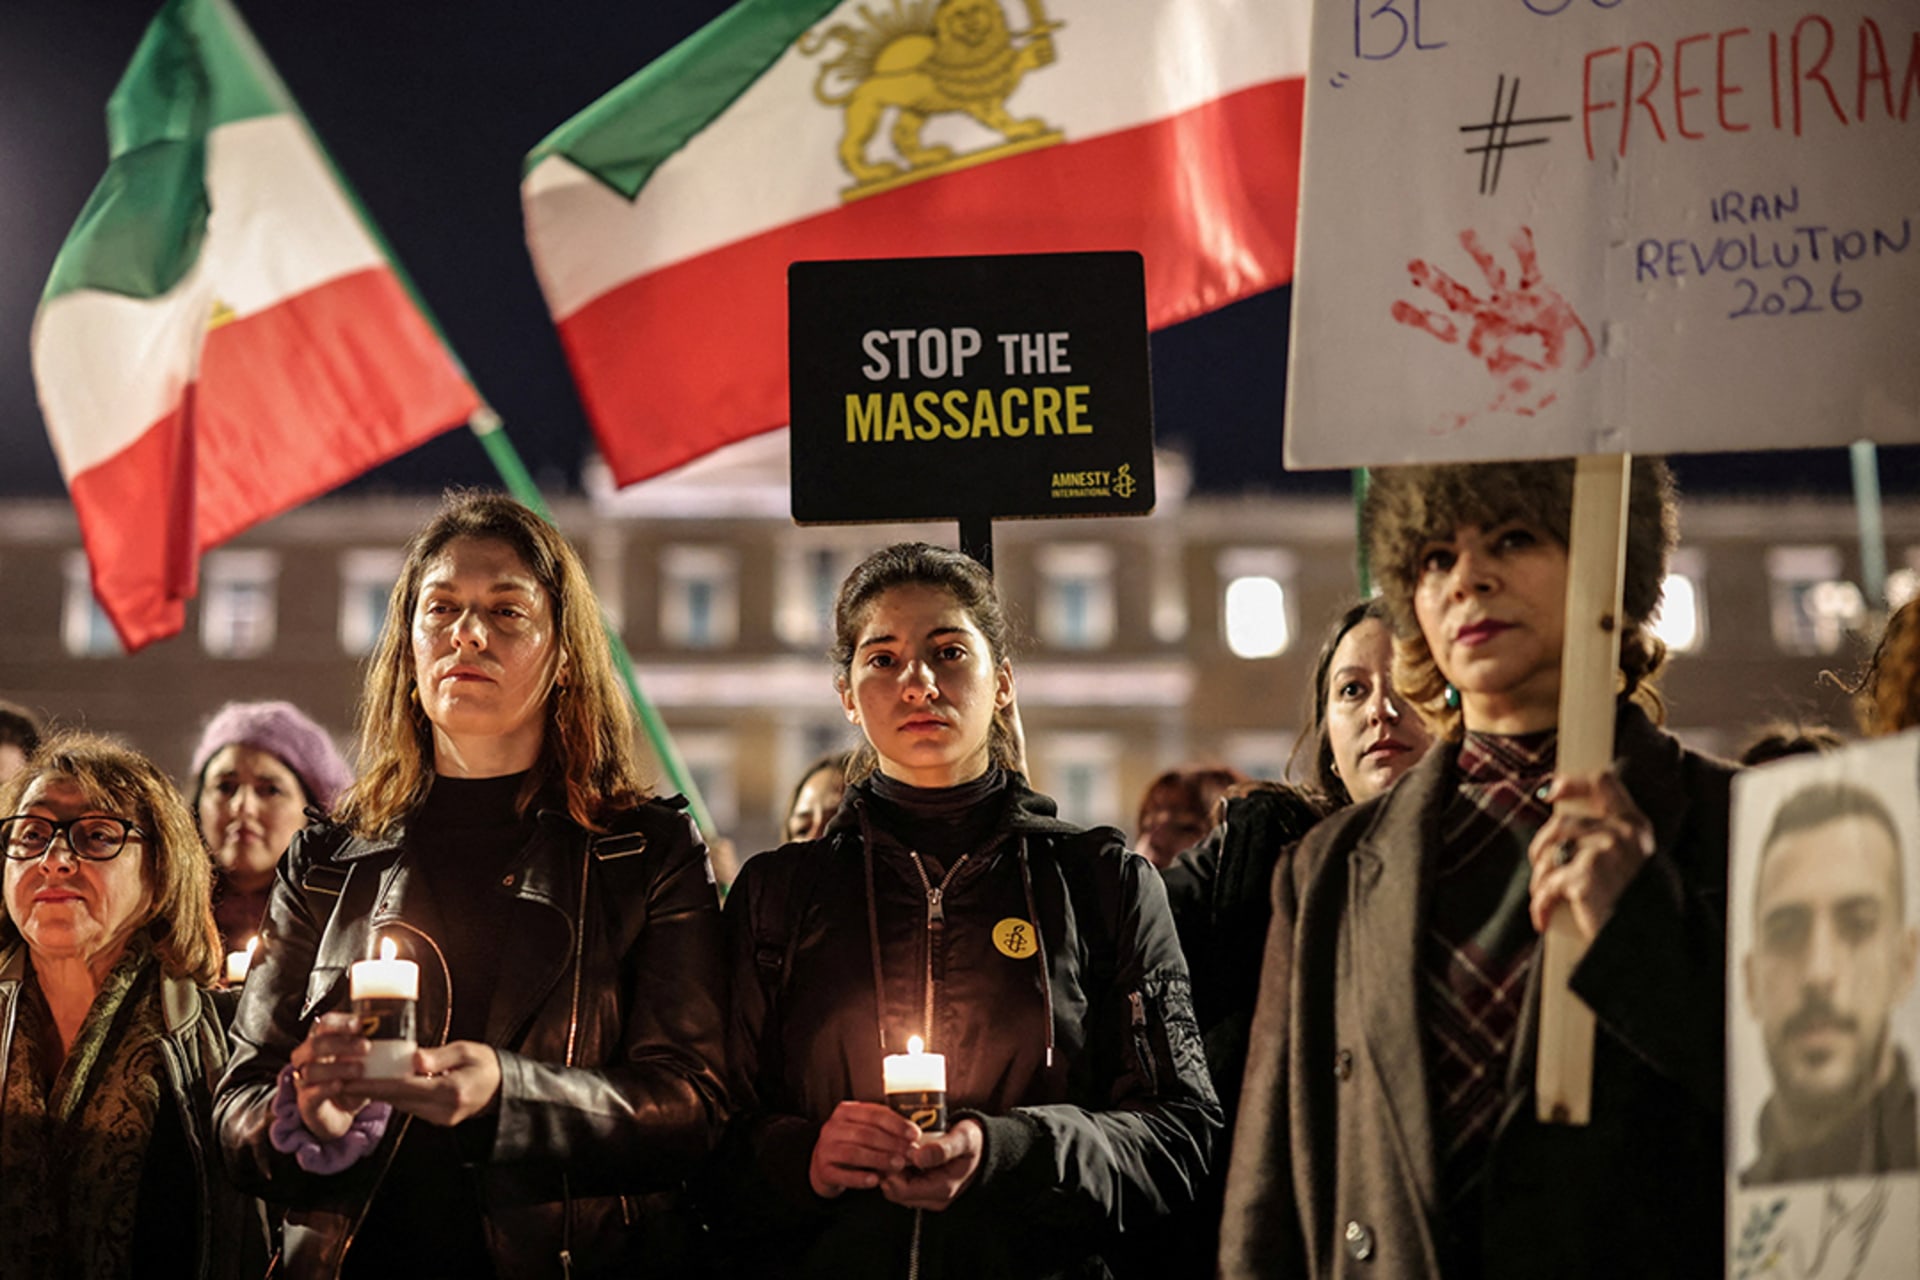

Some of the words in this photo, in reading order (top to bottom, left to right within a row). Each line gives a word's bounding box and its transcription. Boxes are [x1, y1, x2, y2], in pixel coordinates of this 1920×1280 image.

[1710, 186, 1798, 225] IRAN
[1635, 219, 1911, 282] REVOLUTION
[1728, 272, 1863, 319] 2026
[862, 328, 982, 381] STOP
[997, 332, 1072, 376] THE
[845, 385, 1094, 443] MASSACRE
[1051, 471, 1111, 488] AMNESTY
